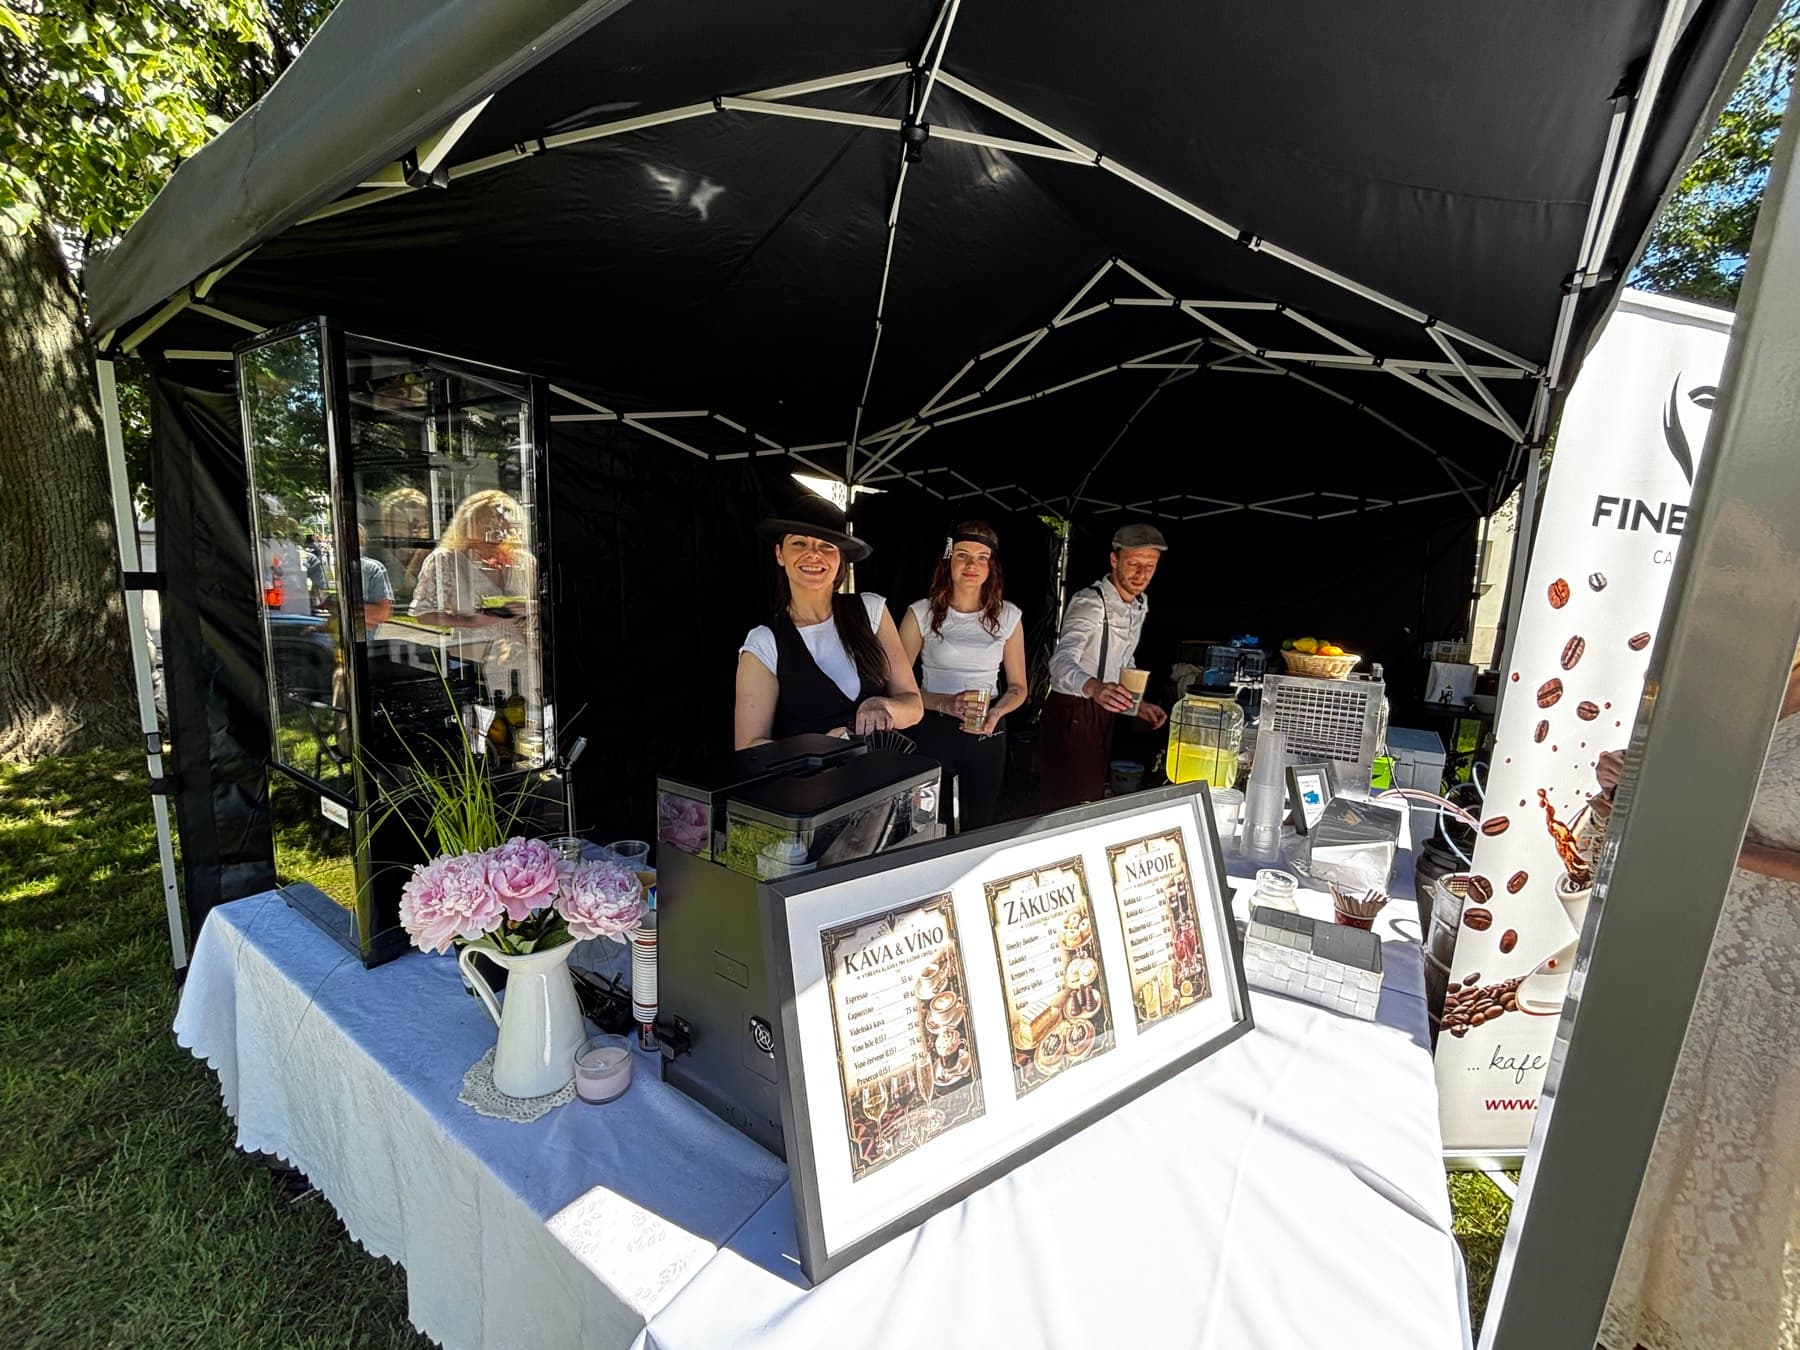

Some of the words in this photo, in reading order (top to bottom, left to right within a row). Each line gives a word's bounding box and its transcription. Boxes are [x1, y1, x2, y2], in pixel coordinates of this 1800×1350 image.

[1125, 852, 1177, 883] NÁPOJE
[1003, 883, 1076, 925] ZÁKUSKY
[843, 945, 894, 975] KÁVA
[895, 942, 904, 956] &
[904, 926, 944, 953] VÍNO
[845, 992, 868, 1005] Espresso
[856, 1072, 879, 1087] Prosecco
[1488, 1044, 1547, 1085] kafe
[1485, 1099, 1538, 1111] www.
